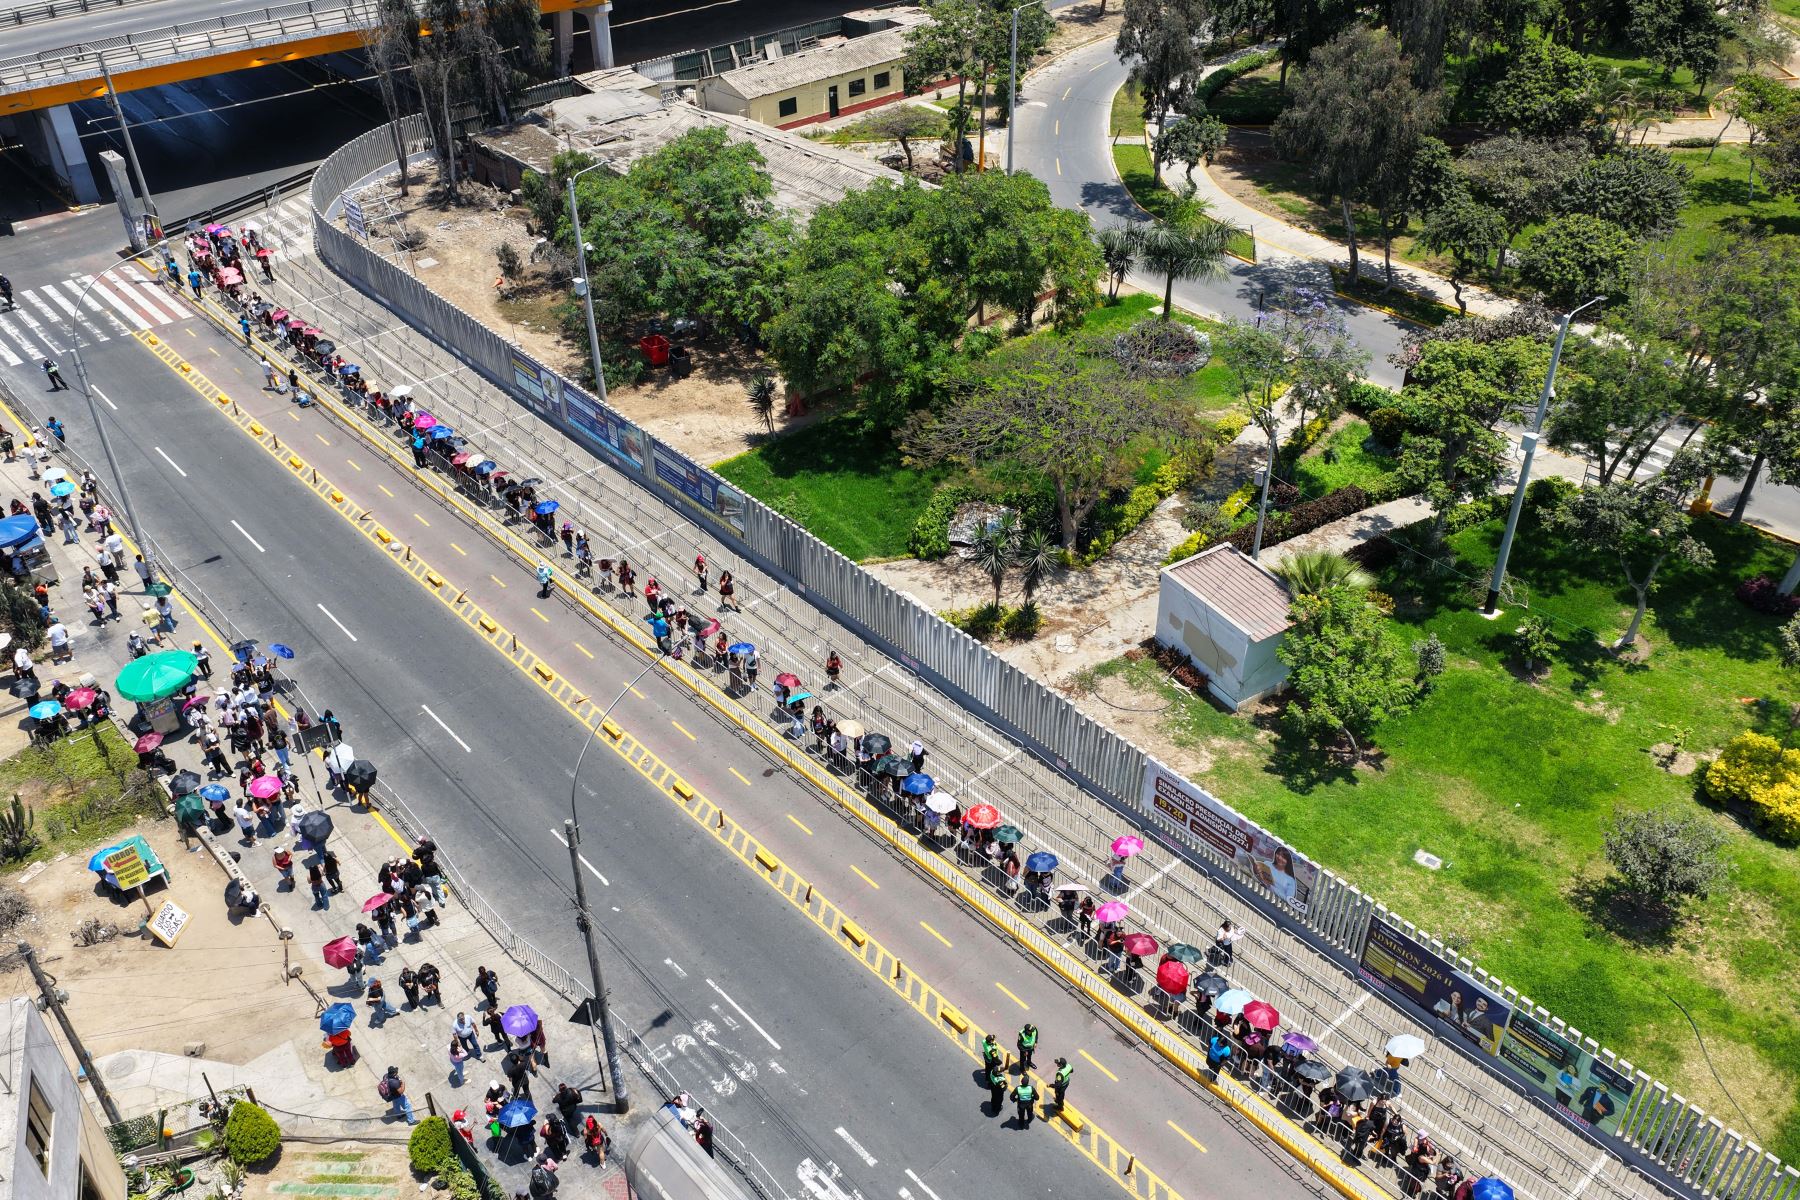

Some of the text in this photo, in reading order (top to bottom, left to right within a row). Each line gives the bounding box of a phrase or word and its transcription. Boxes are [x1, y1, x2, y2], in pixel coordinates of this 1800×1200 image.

[1158, 785, 1185, 807] EXAMEN
[1185, 803, 1195, 813] DE
[1195, 810, 1227, 835] ADMISIÓN
[1158, 779, 1194, 806] SIMULACRO
[1195, 803, 1234, 832] PRESENCIAL
[1235, 829, 1247, 842] DEL
[1159, 797, 1167, 808] 19
[1173, 808, 1184, 820] 20
[108, 846, 136, 864] LIBROS
[155, 904, 173, 927] GUARDO
[161, 919, 171, 931] TUS
[166, 917, 182, 938] COSAS
[1372, 930, 1421, 965] ADMISIÓN
[1422, 963, 1442, 981] 2026
